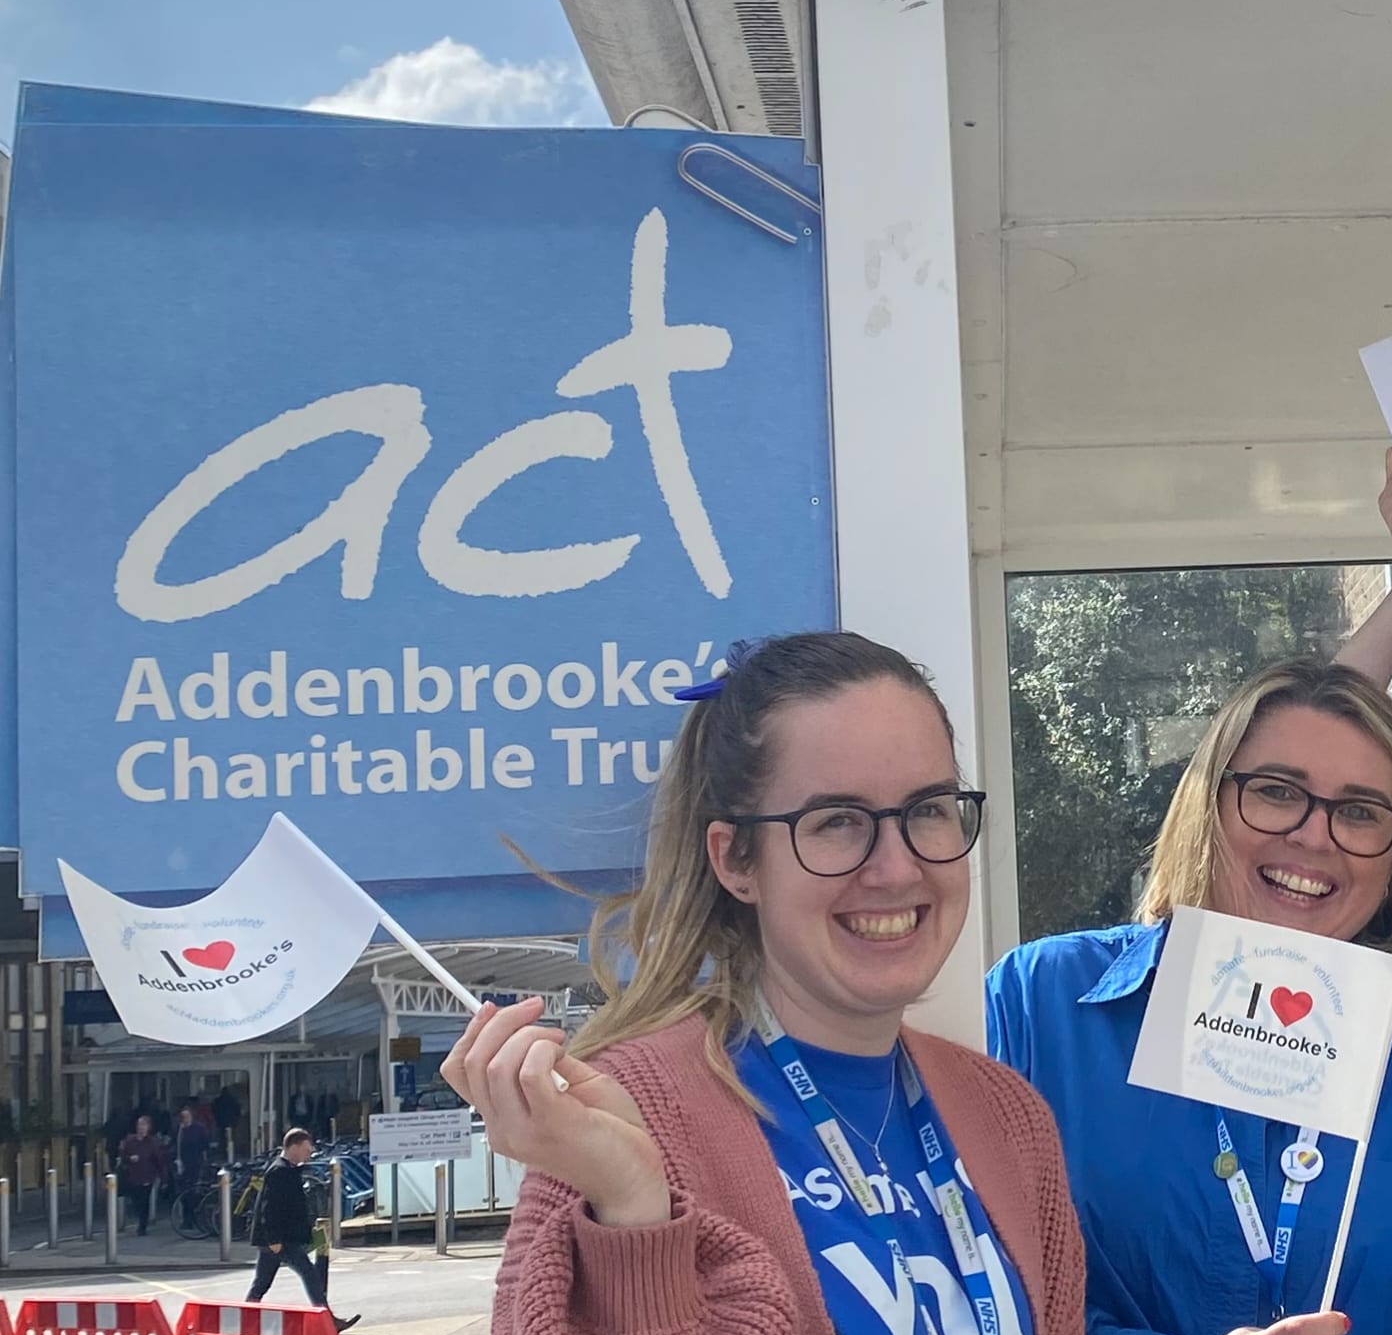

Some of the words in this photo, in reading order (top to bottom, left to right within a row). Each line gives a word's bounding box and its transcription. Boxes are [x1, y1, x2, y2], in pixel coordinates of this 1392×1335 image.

[113, 206, 733, 623] act
[116, 727, 536, 803] Charitable
[551, 726, 673, 787] Tru
[137, 938, 294, 993] Addenbrooke's
[159, 949, 187, 978] I
[1254, 946, 1308, 964] fundraise
[1312, 964, 1344, 1017] volunteer
[1246, 982, 1263, 1020] I
[1193, 1011, 1338, 1061] Addenbrooke's
[786, 1064, 815, 1096] NHS
[919, 1127, 942, 1159] NHS
[1217, 1125, 1231, 1151] NHS
[834, 1143, 850, 1169] name
[1286, 1149, 1298, 1170] I
[959, 1229, 973, 1254] name
[1275, 1229, 1290, 1263] NHS
[978, 1300, 998, 1335] NHS
